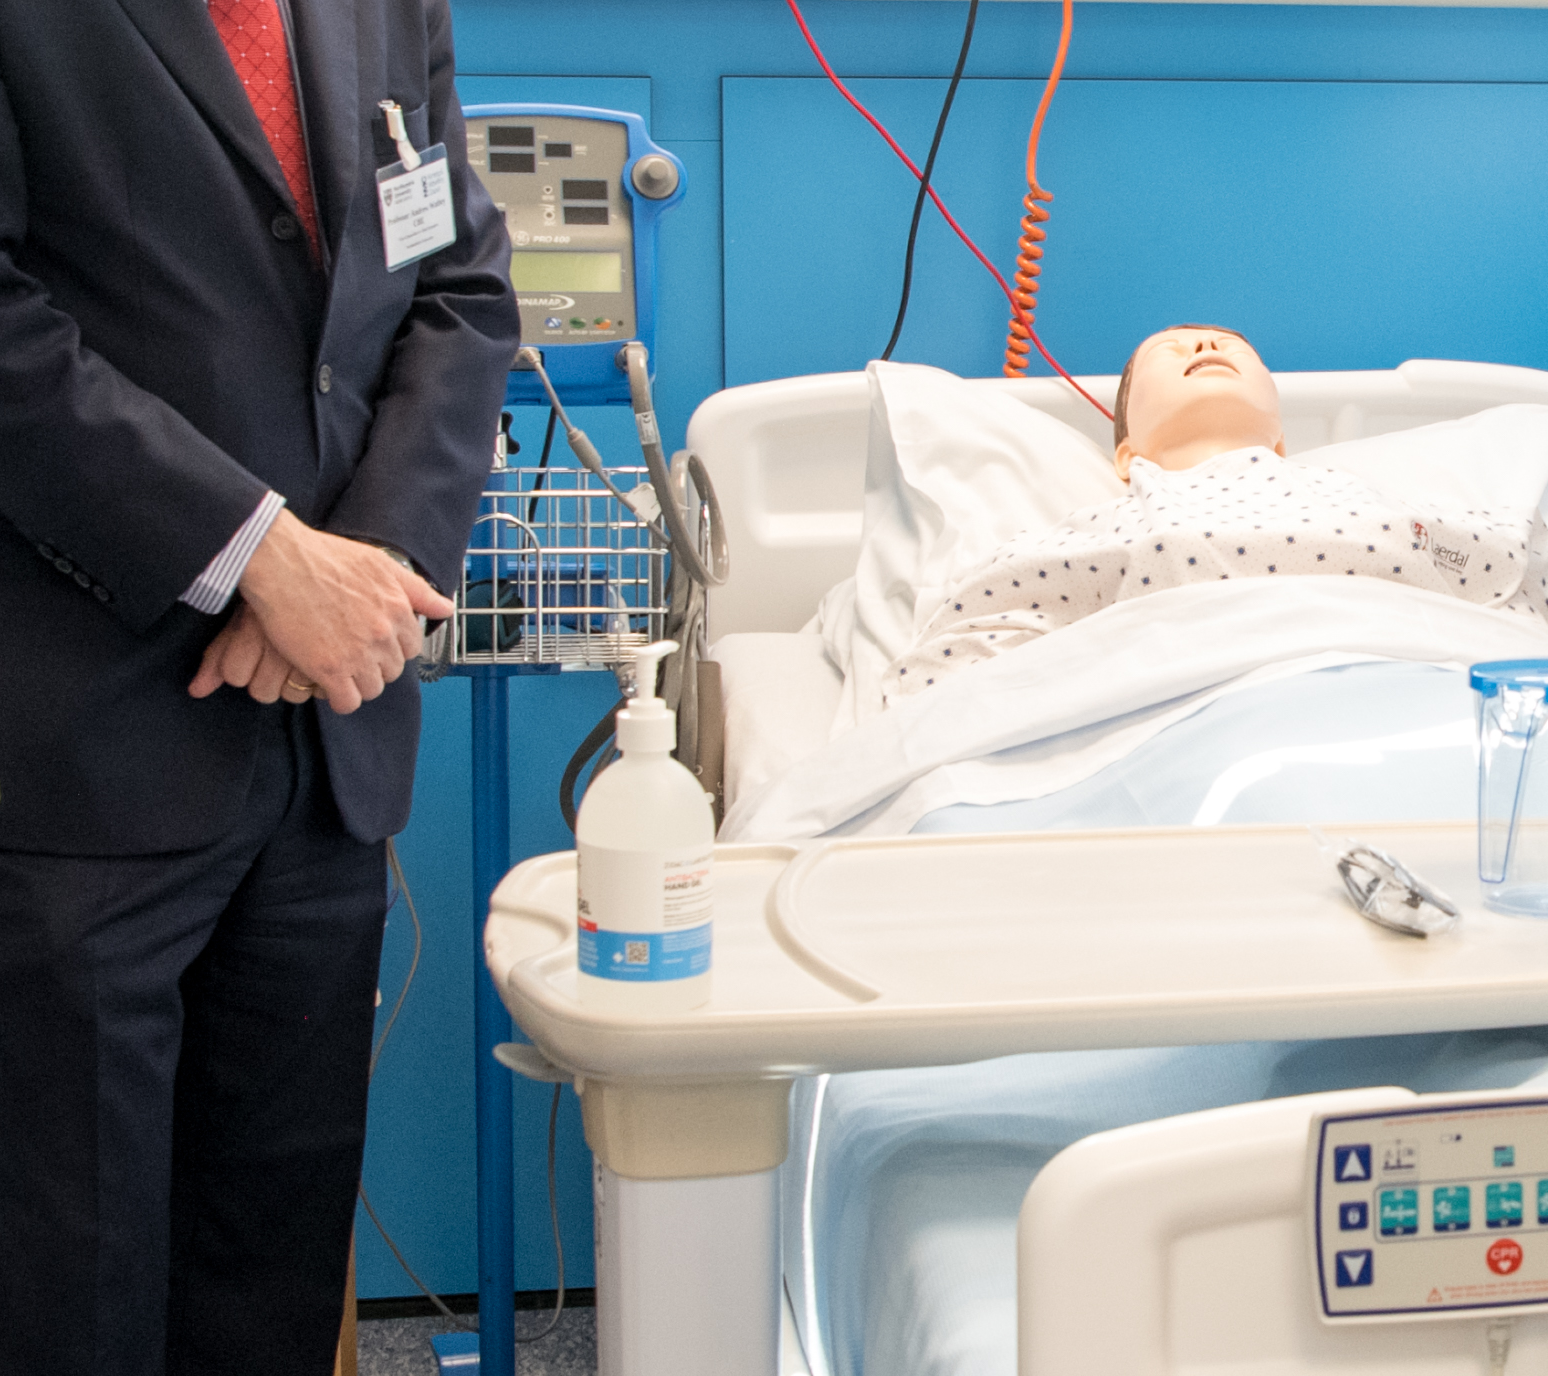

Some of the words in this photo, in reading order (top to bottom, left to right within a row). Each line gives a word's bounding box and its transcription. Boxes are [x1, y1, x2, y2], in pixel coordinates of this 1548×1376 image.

[533, 235, 553, 243] PRO
[1431, 537, 1470, 567] Laerdal
[664, 882, 689, 891] HAND
[1490, 1247, 1520, 1260] CPR
